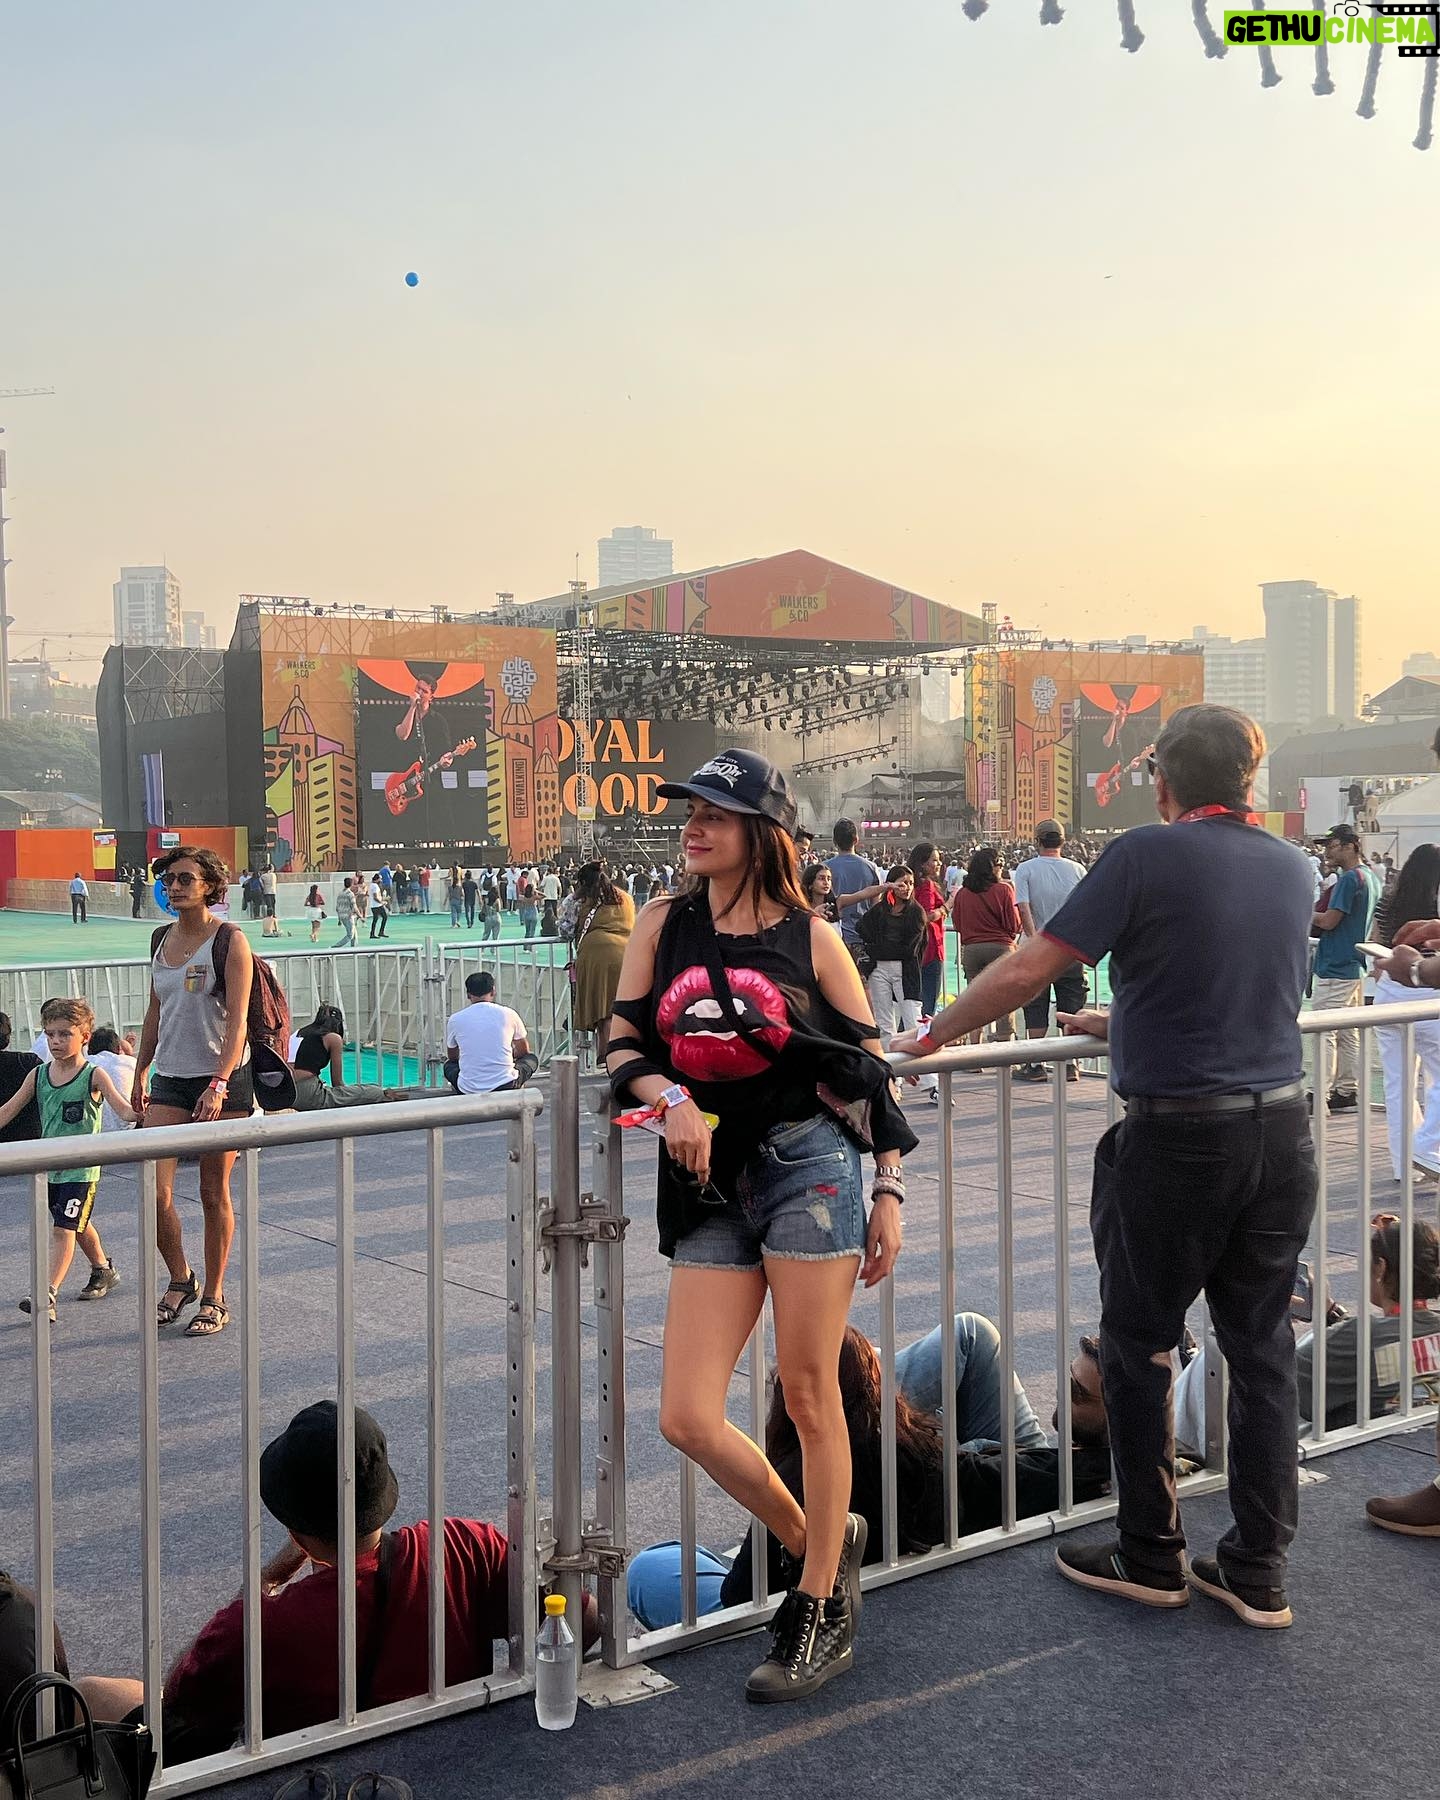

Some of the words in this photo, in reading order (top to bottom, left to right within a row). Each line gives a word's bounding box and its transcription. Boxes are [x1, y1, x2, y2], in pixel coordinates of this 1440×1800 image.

[779, 594, 818, 609] WALKERS
[286, 660, 316, 669] WALKERS
[514, 761, 525, 796] WALKING
[559, 772, 670, 817] OOD
[515, 797, 526, 816] KEEP
[63, 1198, 82, 1219] 6
